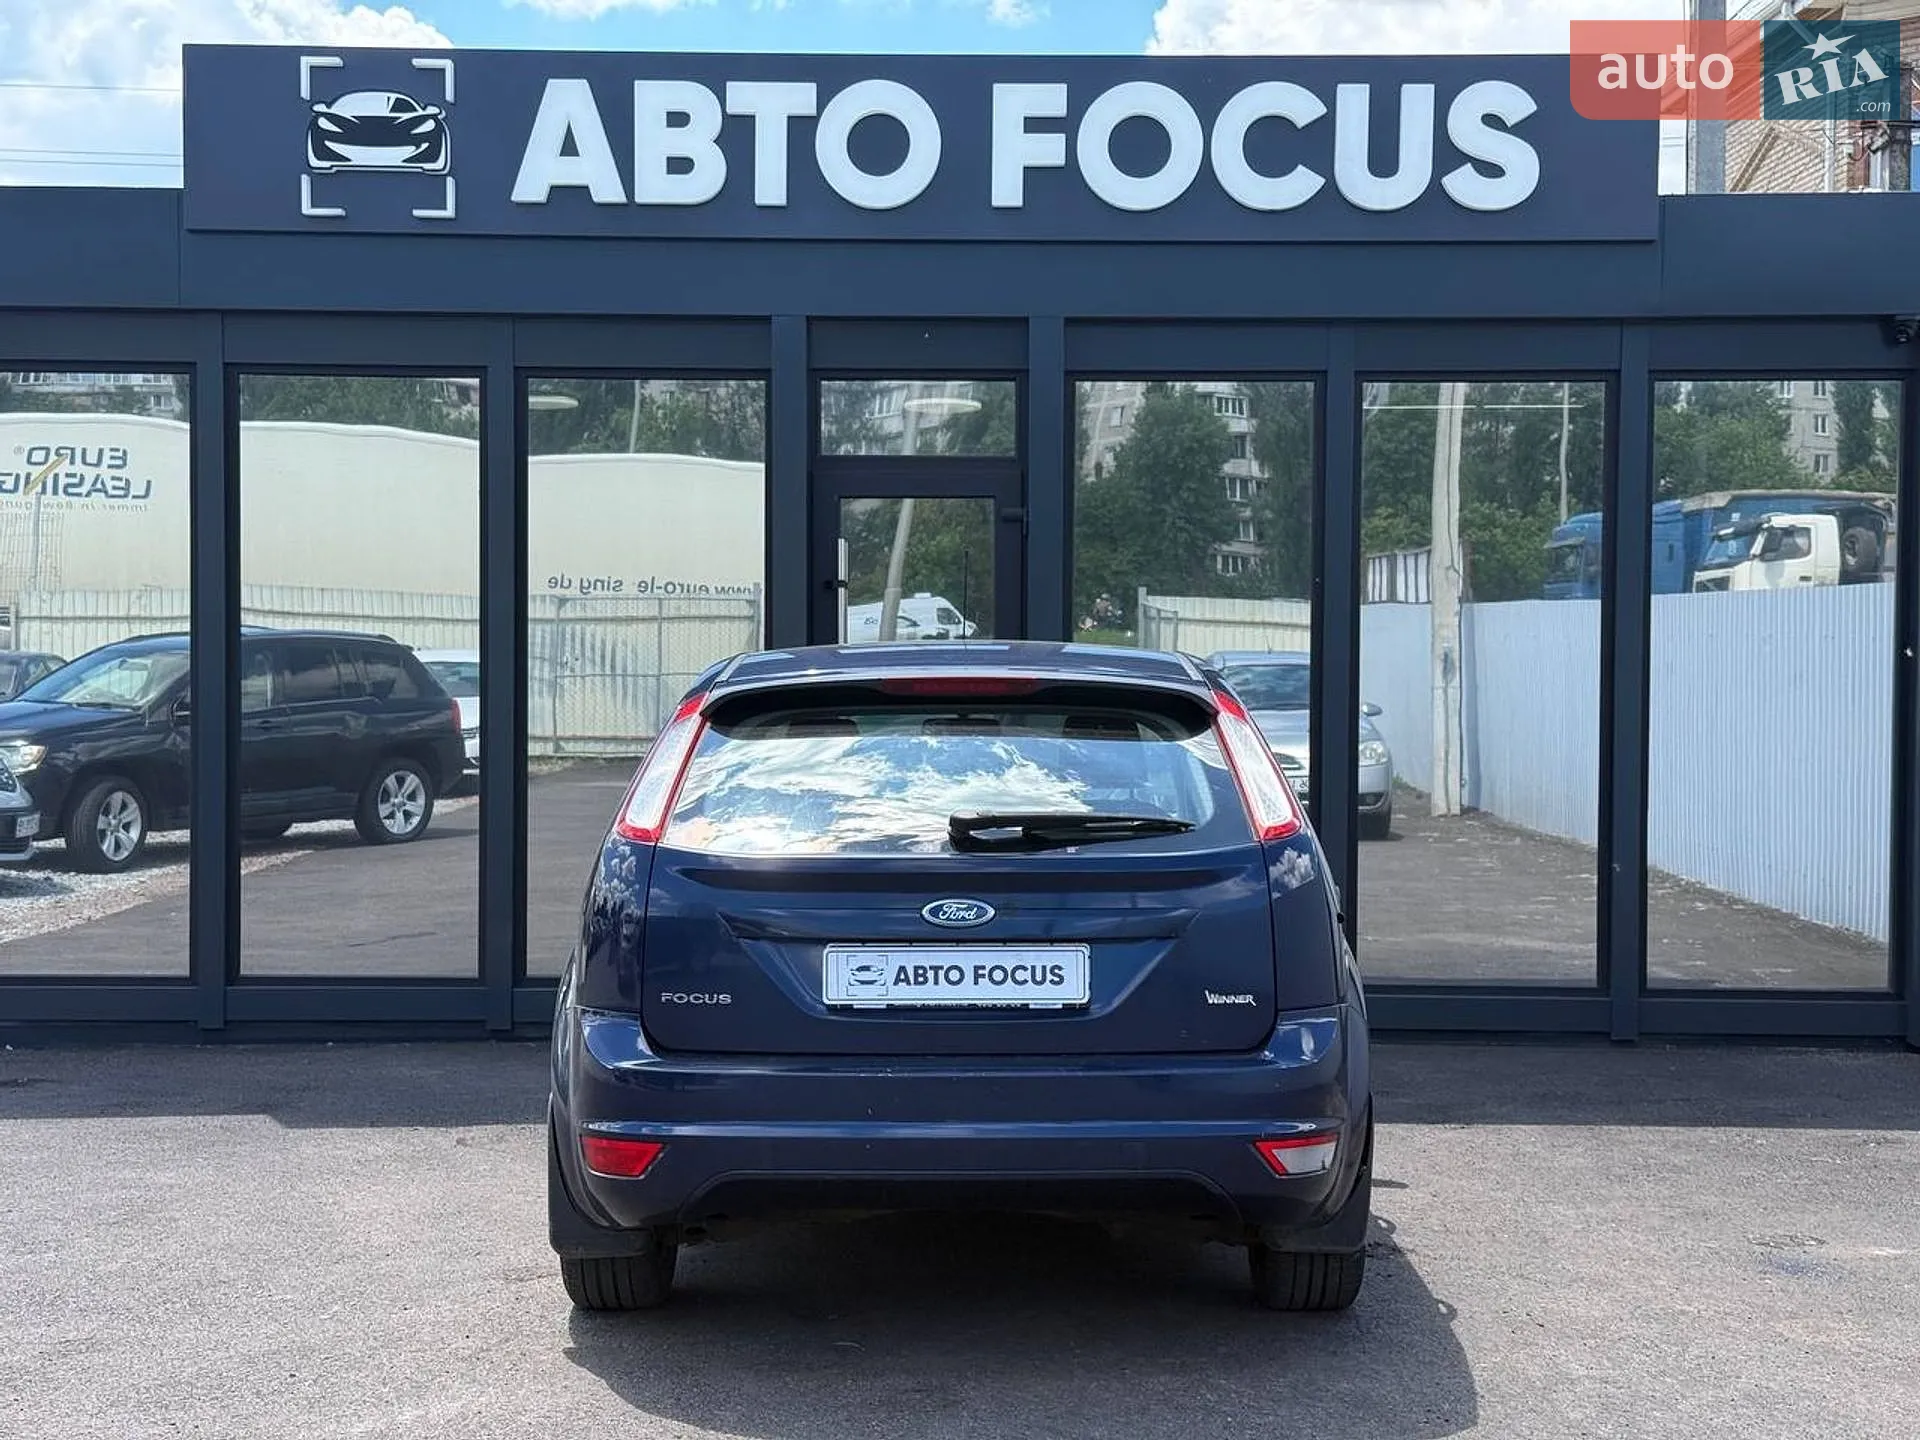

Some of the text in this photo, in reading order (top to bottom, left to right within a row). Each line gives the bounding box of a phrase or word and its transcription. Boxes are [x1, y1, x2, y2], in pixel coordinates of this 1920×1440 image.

[510, 78, 1540, 212] АВТО FOCUS
[939, 903, 978, 920] Ford
[892, 964, 1065, 986] АВТО FOCUS
[660, 992, 732, 1005] FOCUS
